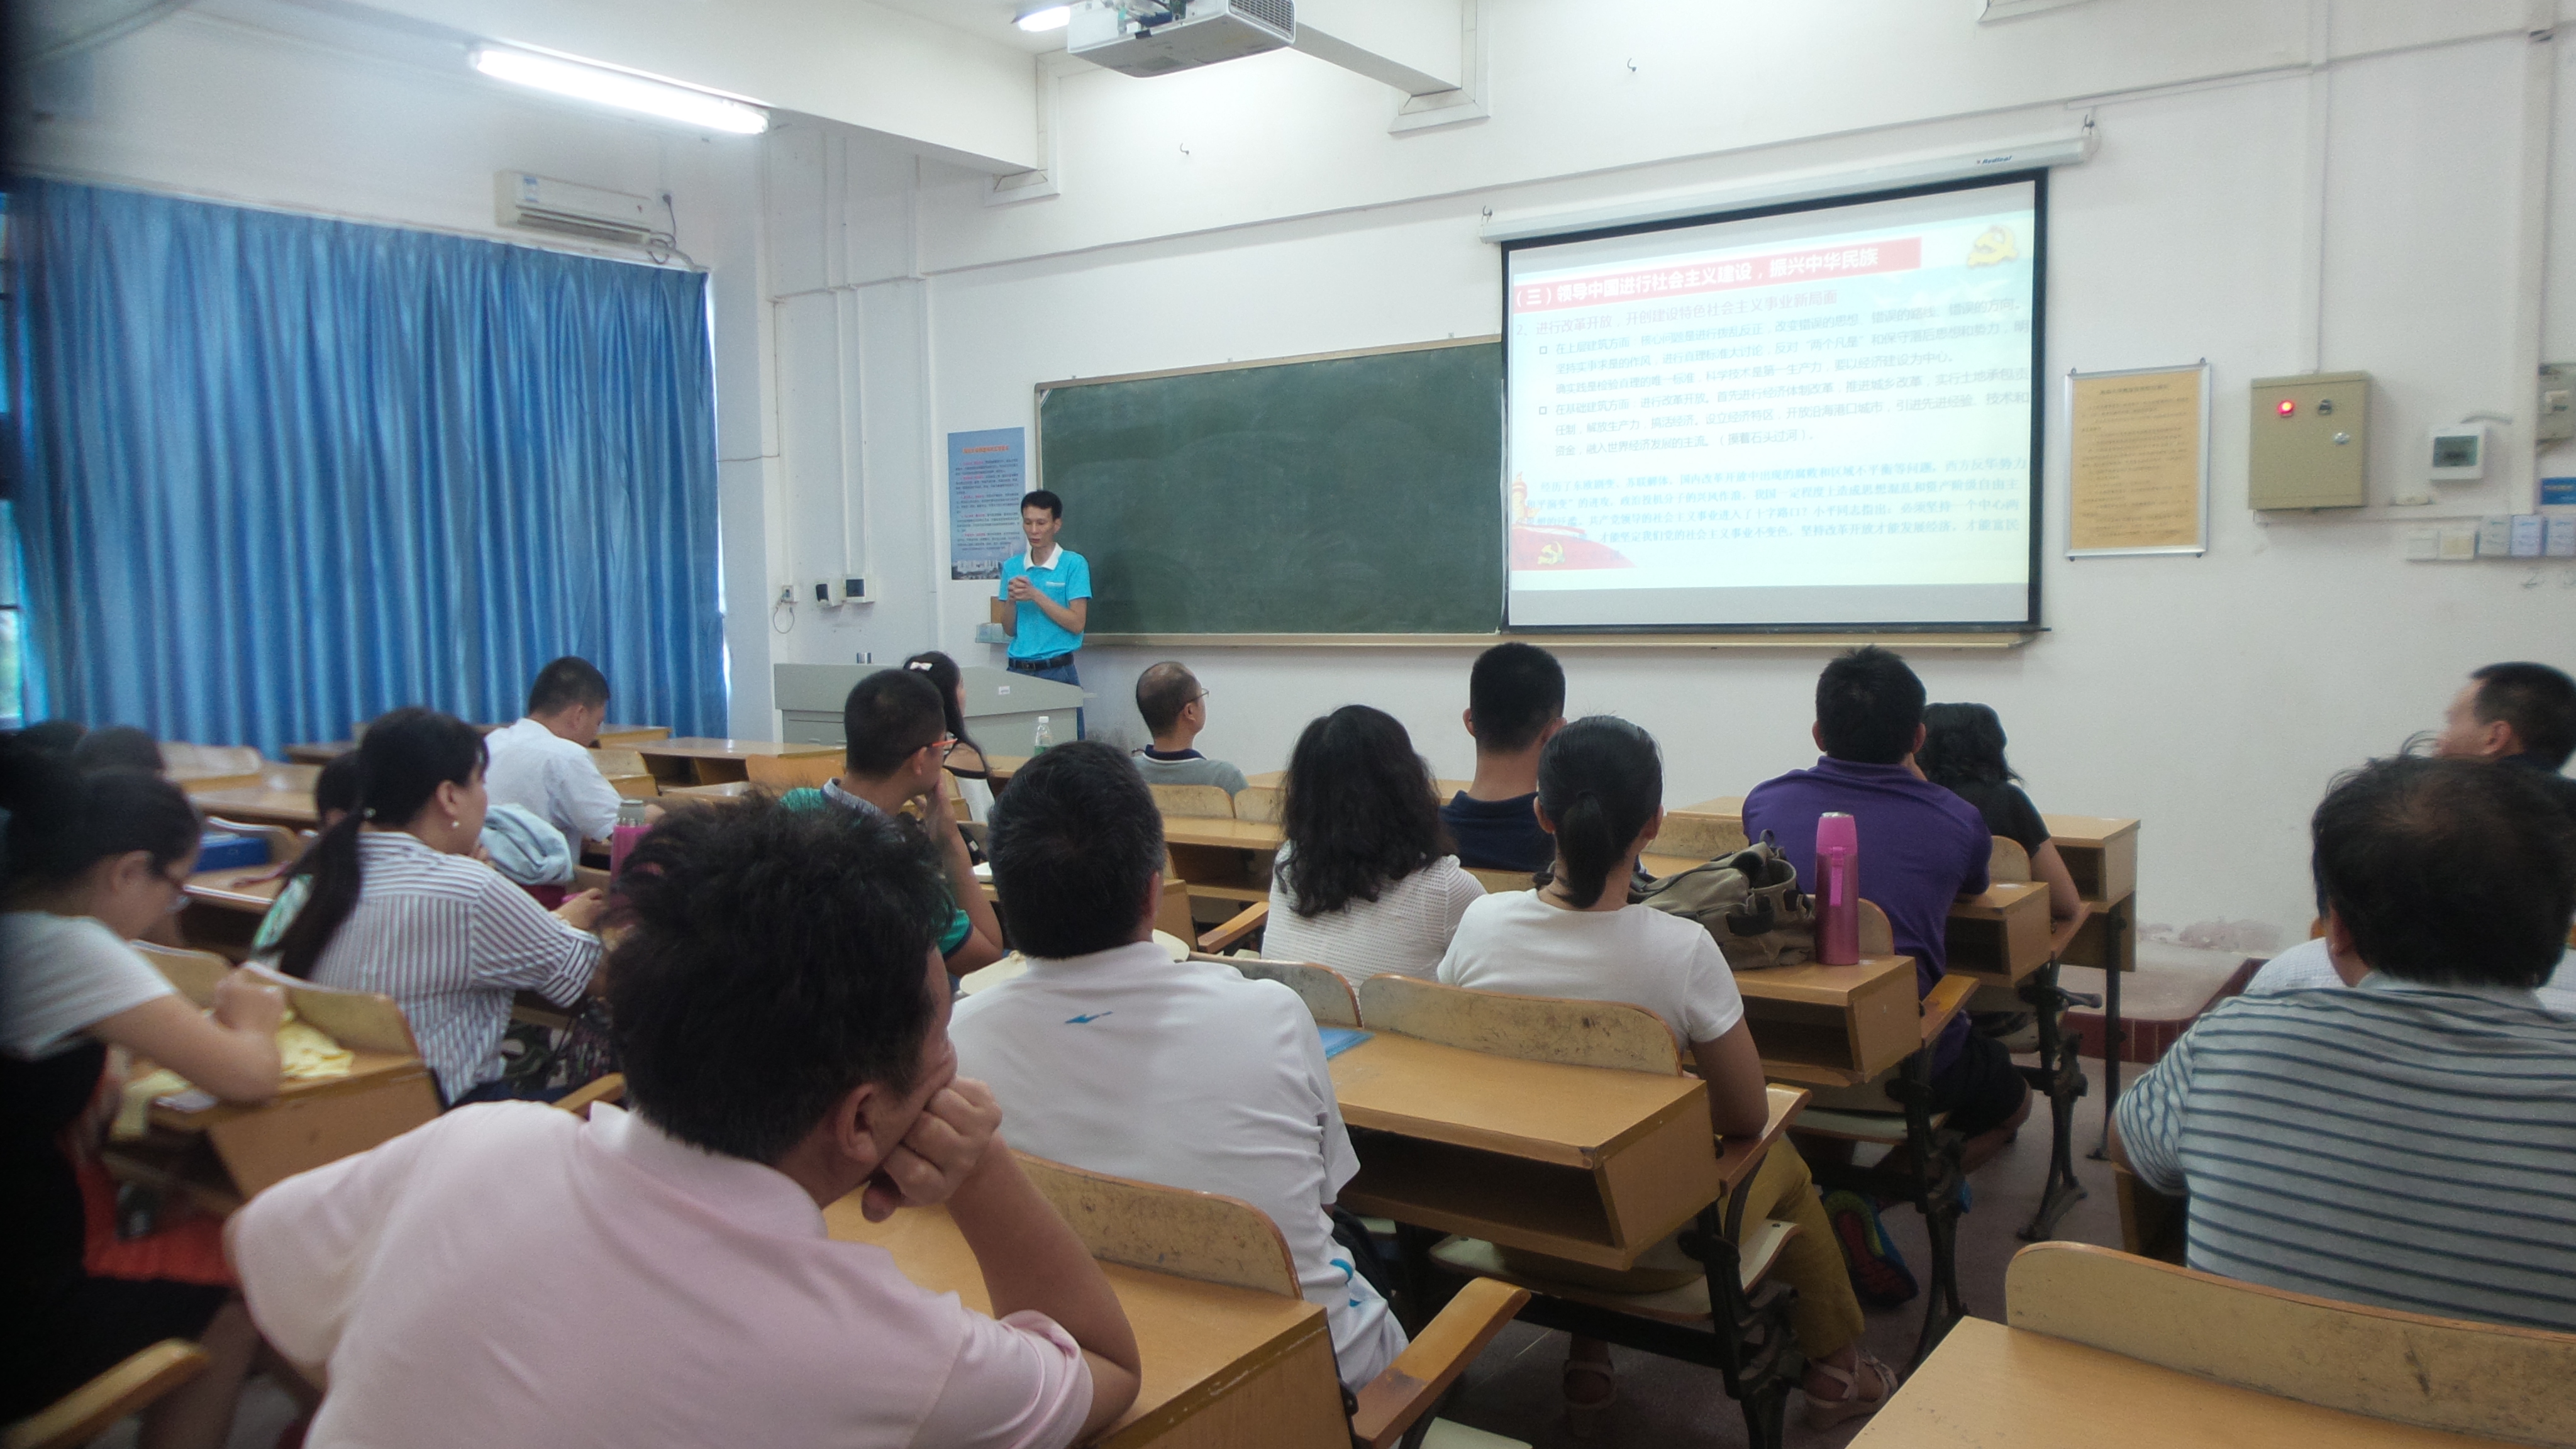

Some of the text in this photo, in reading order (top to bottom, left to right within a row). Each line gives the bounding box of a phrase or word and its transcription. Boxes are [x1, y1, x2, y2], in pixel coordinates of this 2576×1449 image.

[1516, 246, 1878, 308] （三）领导中国进行社会主义建设，振兴中华民族
